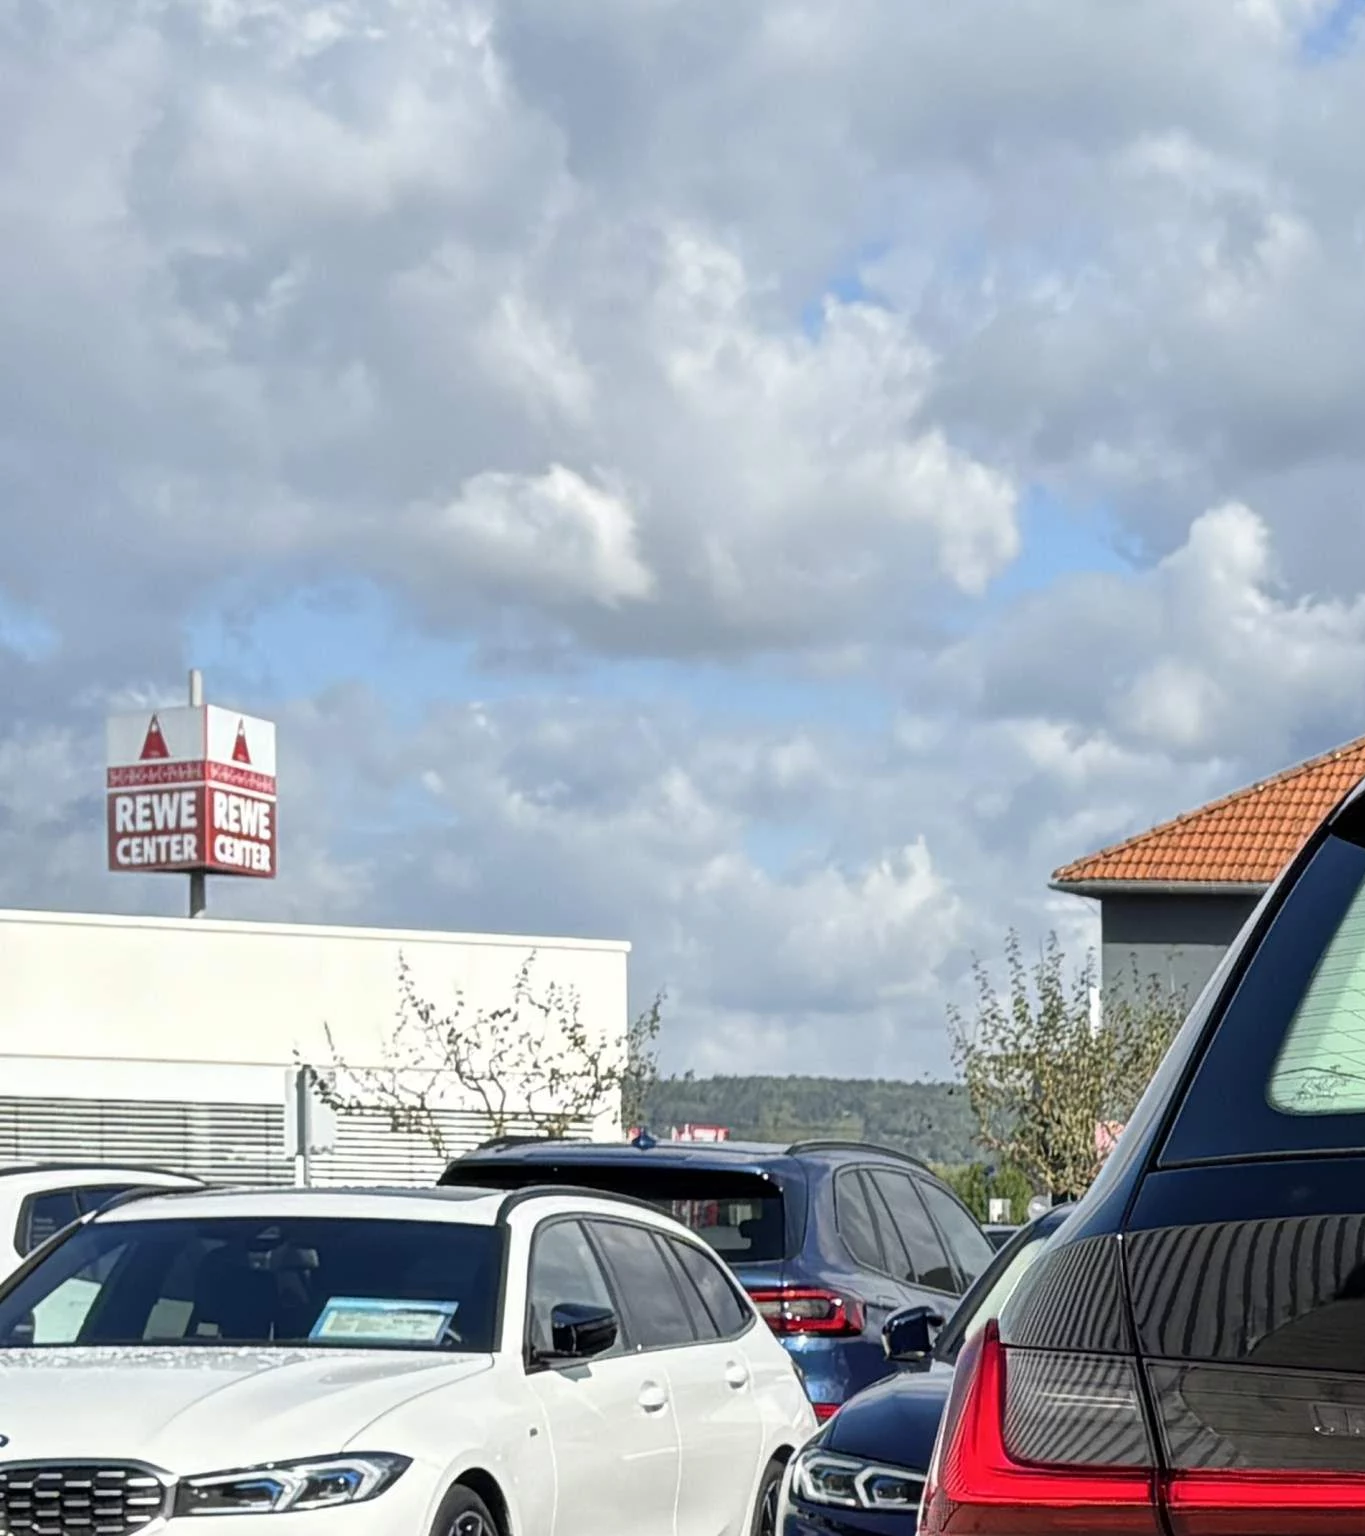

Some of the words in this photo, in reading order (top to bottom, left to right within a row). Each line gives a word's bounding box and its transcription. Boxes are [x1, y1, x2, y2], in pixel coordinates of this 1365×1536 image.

[115, 790, 198, 833] REWE
[213, 791, 272, 840] REWE
[116, 833, 198, 866] CENTER
[214, 833, 272, 872] CENTER
